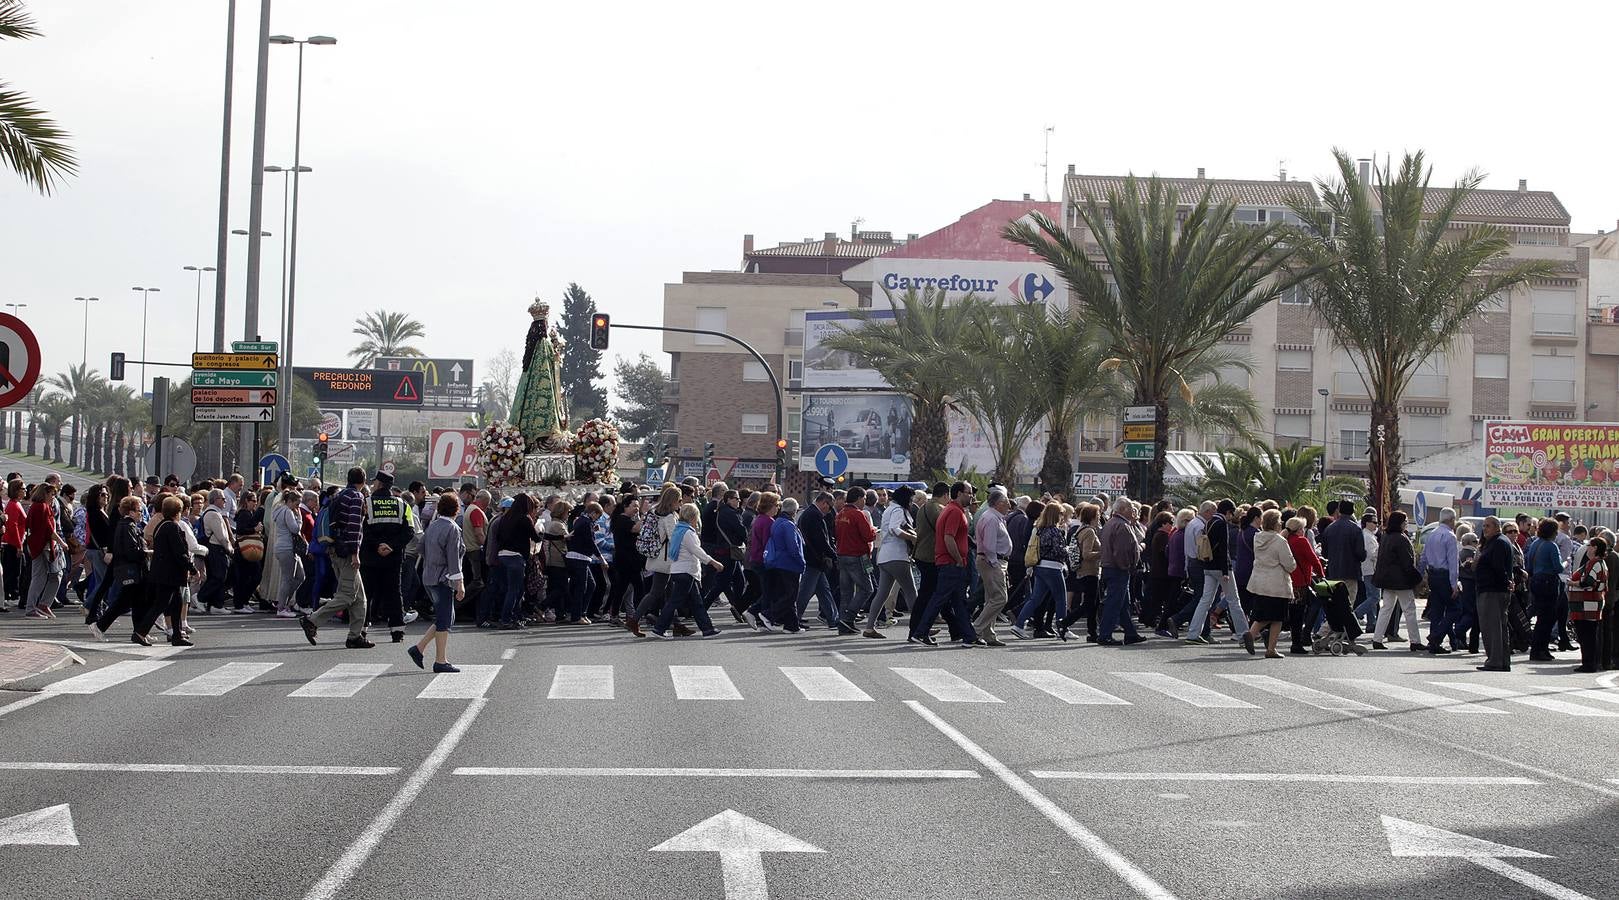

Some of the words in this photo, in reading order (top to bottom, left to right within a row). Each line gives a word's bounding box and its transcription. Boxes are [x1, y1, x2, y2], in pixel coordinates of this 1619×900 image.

[884, 273, 998, 292] Carrefour
[218, 377, 241, 386] Mayo
[313, 372, 372, 382] PRECAUCION
[330, 382, 372, 390] REDONDA
[1492, 428, 1528, 442] CASH
[1532, 428, 1560, 442] GRAN
[1563, 428, 1605, 442] OFERTA
[1546, 444, 1566, 461] DE
